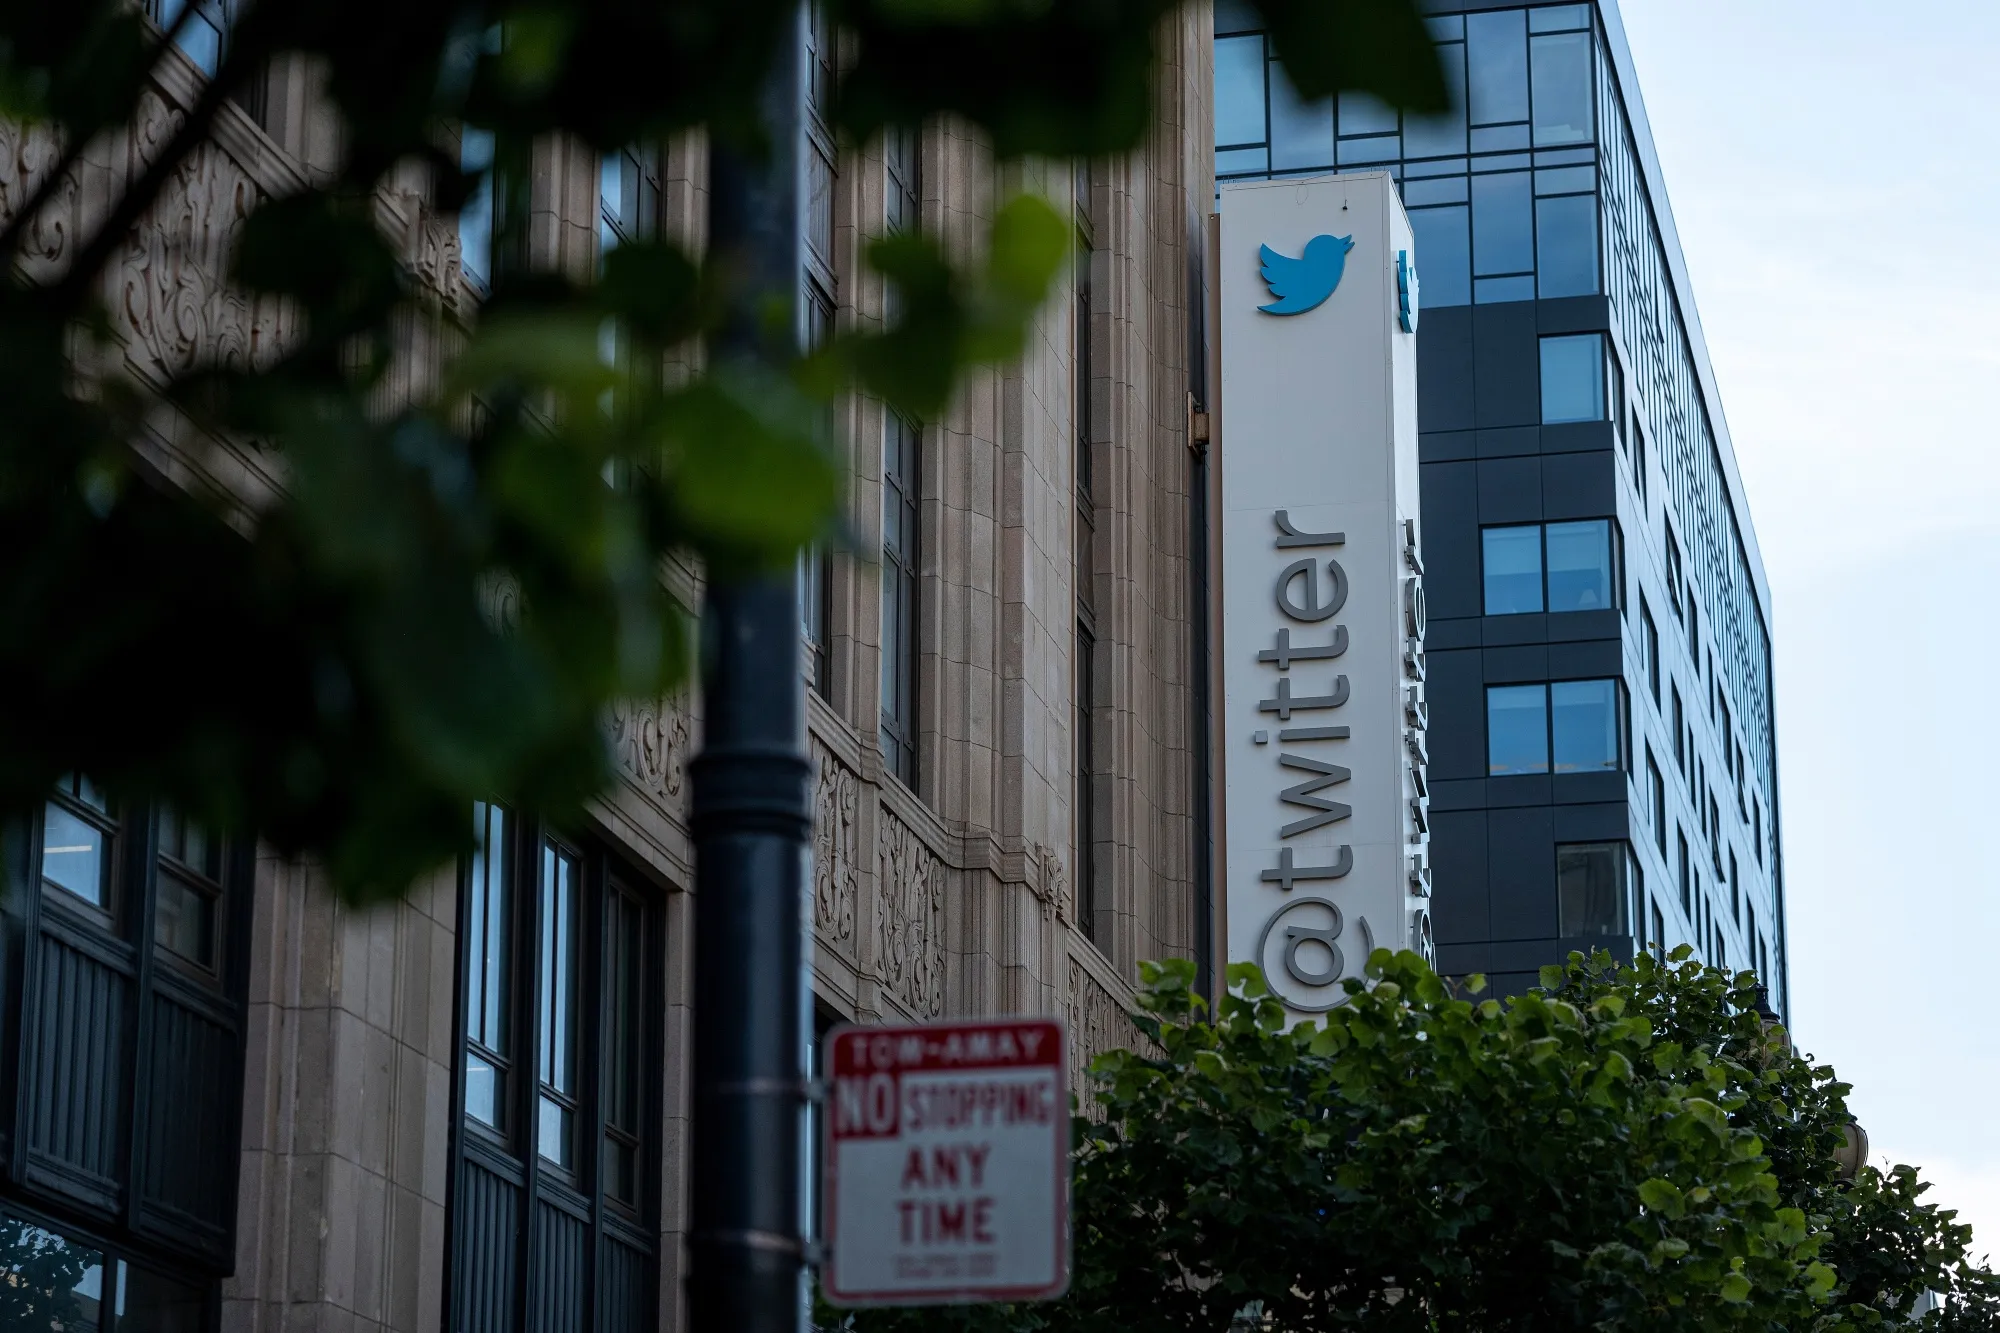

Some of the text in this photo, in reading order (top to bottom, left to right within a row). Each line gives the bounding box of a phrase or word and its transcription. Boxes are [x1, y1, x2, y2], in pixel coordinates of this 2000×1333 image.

[1255, 510, 1375, 1013] @twitter
[852, 1029, 1044, 1069] TOW-AWAY
[836, 1073, 1051, 1133] NO STOPPING
[902, 1146, 990, 1190] ANY
[898, 1197, 995, 1245] TIME
